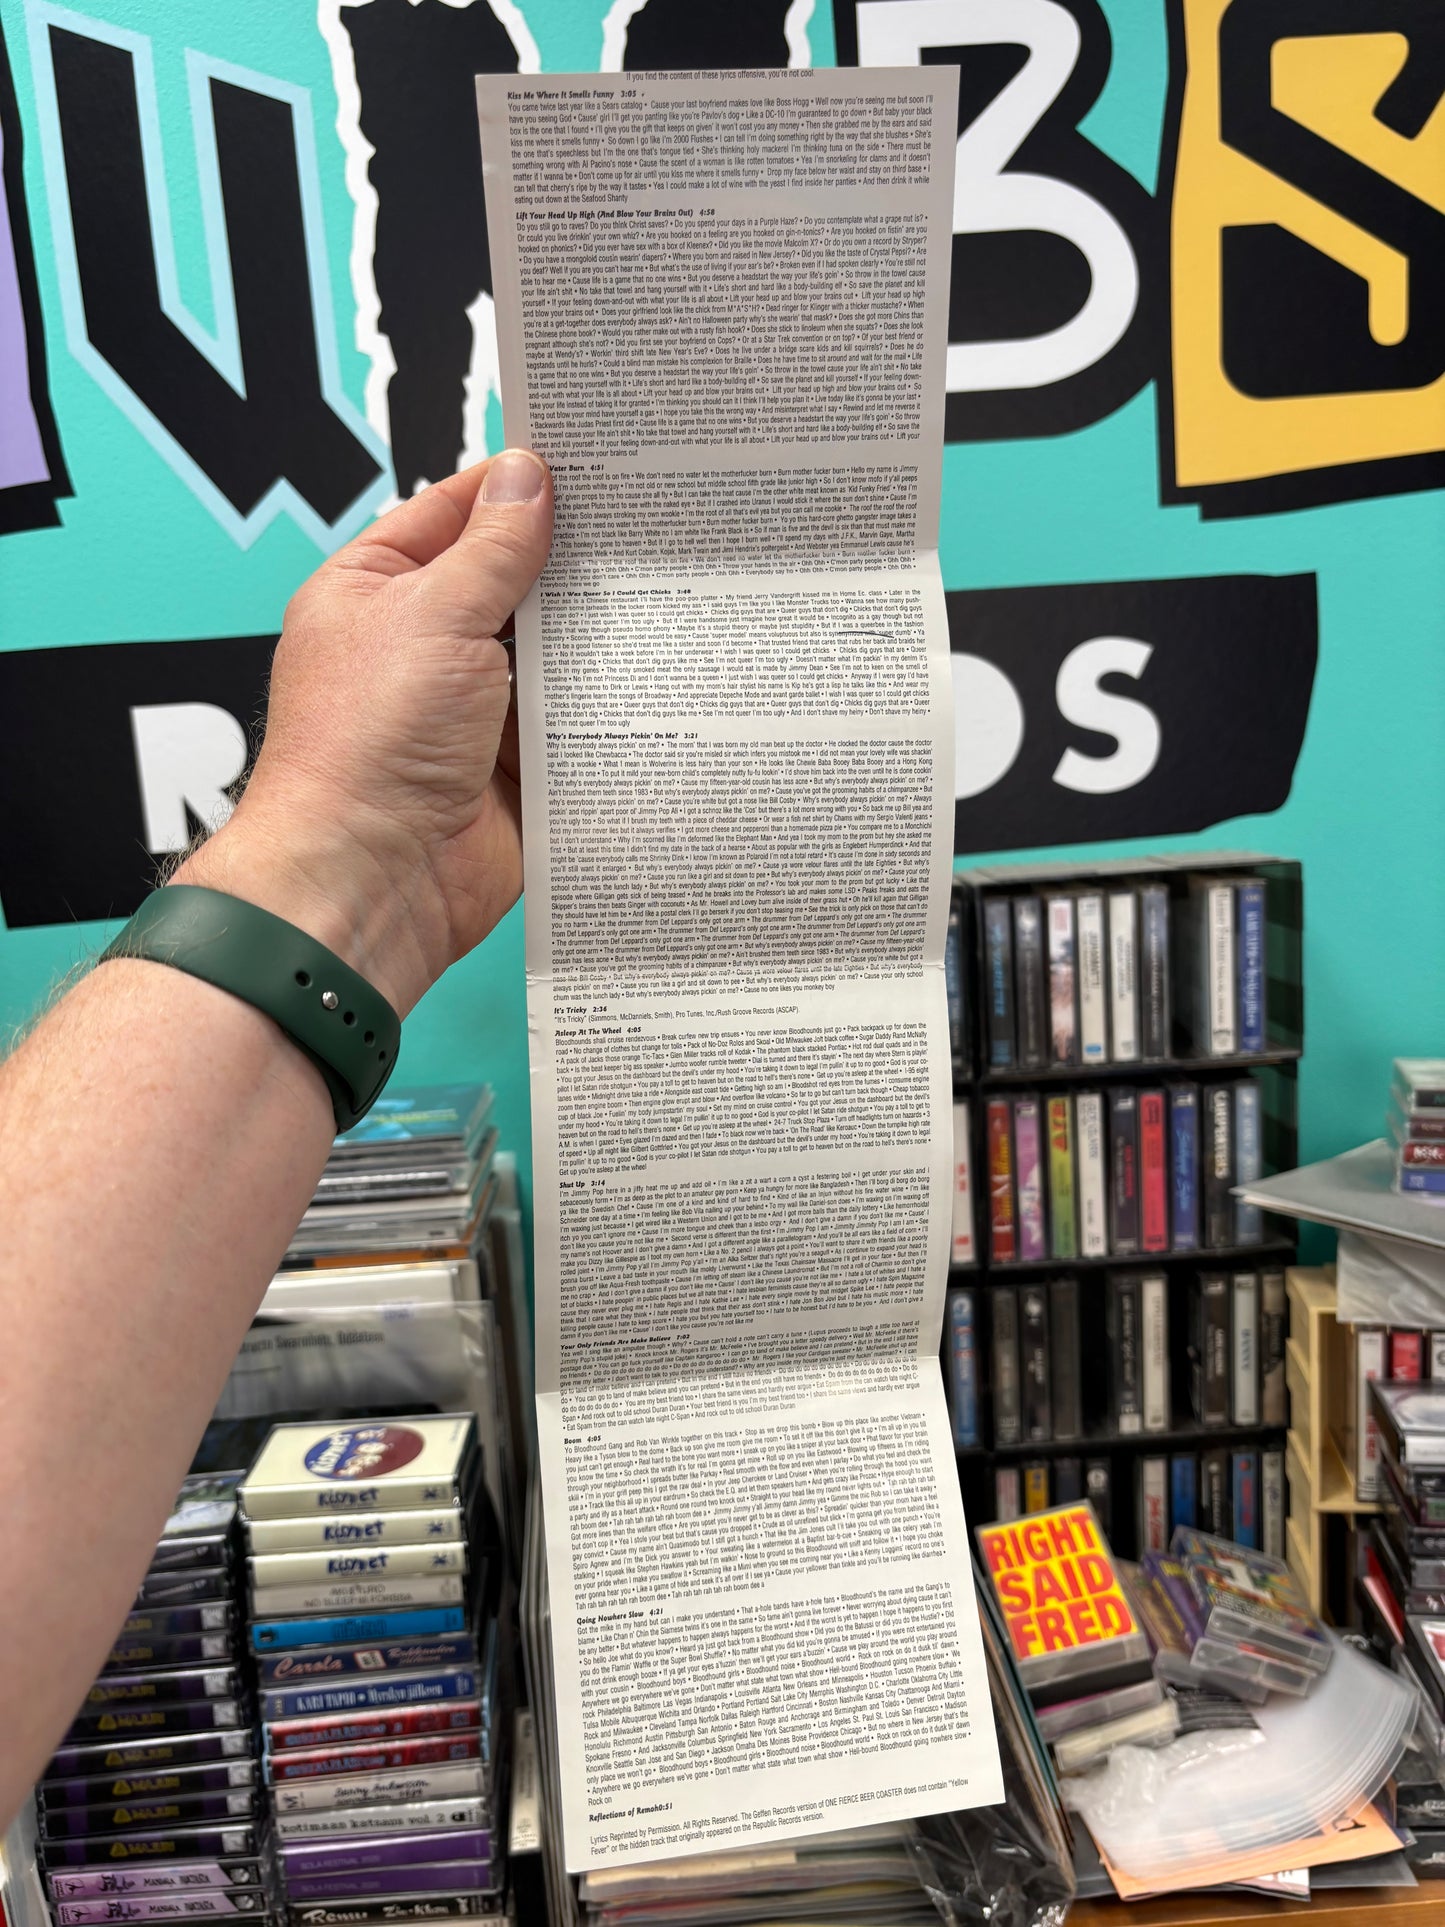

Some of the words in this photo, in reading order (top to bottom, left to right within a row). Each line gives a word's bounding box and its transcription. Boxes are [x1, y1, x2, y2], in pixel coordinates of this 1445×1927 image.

[632, 70, 643, 82] you
[645, 70, 656, 80] find
[658, 70, 668, 80] the
[669, 69, 692, 80] content
[701, 69, 718, 79] these
[720, 69, 736, 80] lyrics
[768, 68, 787, 79] you're
[788, 69, 799, 77] not
[507, 91, 521, 99] Kiss
[523, 91, 534, 99] Me
[536, 91, 559, 99] Where
[568, 90, 590, 98] Smells
[592, 90, 614, 99] Funny
[516, 211, 527, 220] Lift
[529, 211, 546, 219] Your
[547, 211, 565, 219] Head
[567, 211, 577, 220] Up
[579, 210, 595, 220] High
[597, 210, 614, 219] (And
[616, 209, 634, 217] Blow
[654, 209, 676, 217] Brains
[678, 208, 693, 217] Out)
[699, 208, 715, 216] 4:58
[545, 732, 566, 741] Why's
[568, 732, 602, 741] Everybody
[604, 732, 628, 740] Always
[566, 1006, 587, 1014] Tricky
[675, 1010, 685, 1018] Pro
[554, 1029, 576, 1037] Asleep
[591, 1179, 605, 1187] 3:14
[981, 1512, 1095, 1573] RIGHT
[1000, 1554, 1114, 1613] SAID
[576, 1616, 596, 1625] Going
[597, 1613, 626, 1622] Nowhere
[628, 1610, 644, 1618] Slow
[649, 1608, 663, 1616] 4:21
[1010, 1595, 1132, 1662] FRED
[588, 1796, 603, 1806] Rock
[604, 1796, 612, 1804] on
[436, 1813, 446, 1824] 2
[589, 1811, 626, 1822] Reflections
[627, 1807, 635, 1817] of
[590, 1834, 608, 1845] Lyrics
[609, 1829, 638, 1841] Reprinted
[639, 1829, 646, 1838] by
[682, 1821, 690, 1829] All
[691, 1819, 710, 1829] Rights
[741, 1812, 751, 1820] The
[752, 1809, 771, 1819] Geffen
[772, 1805, 795, 1816] Records
[796, 1802, 817, 1811] version
[818, 1800, 824, 1808] of
[825, 1797, 837, 1807] ONE
[838, 1794, 858, 1804] FIERCE
[859, 1792, 875, 1801] BEER
[876, 1788, 902, 1799] COASTER
[927, 1782, 947, 1791] contain
[590, 1843, 609, 1855] Fever"
[618, 1840, 628, 1851] the
[629, 1837, 649, 1849] hidden
[650, 1836, 665, 1846] track
[666, 1835, 678, 1843] that
[678, 1830, 705, 1842] originally
[706, 1826, 732, 1838] appeared
[752, 1819, 777, 1830] Republic
[778, 1816, 801, 1825] Records
